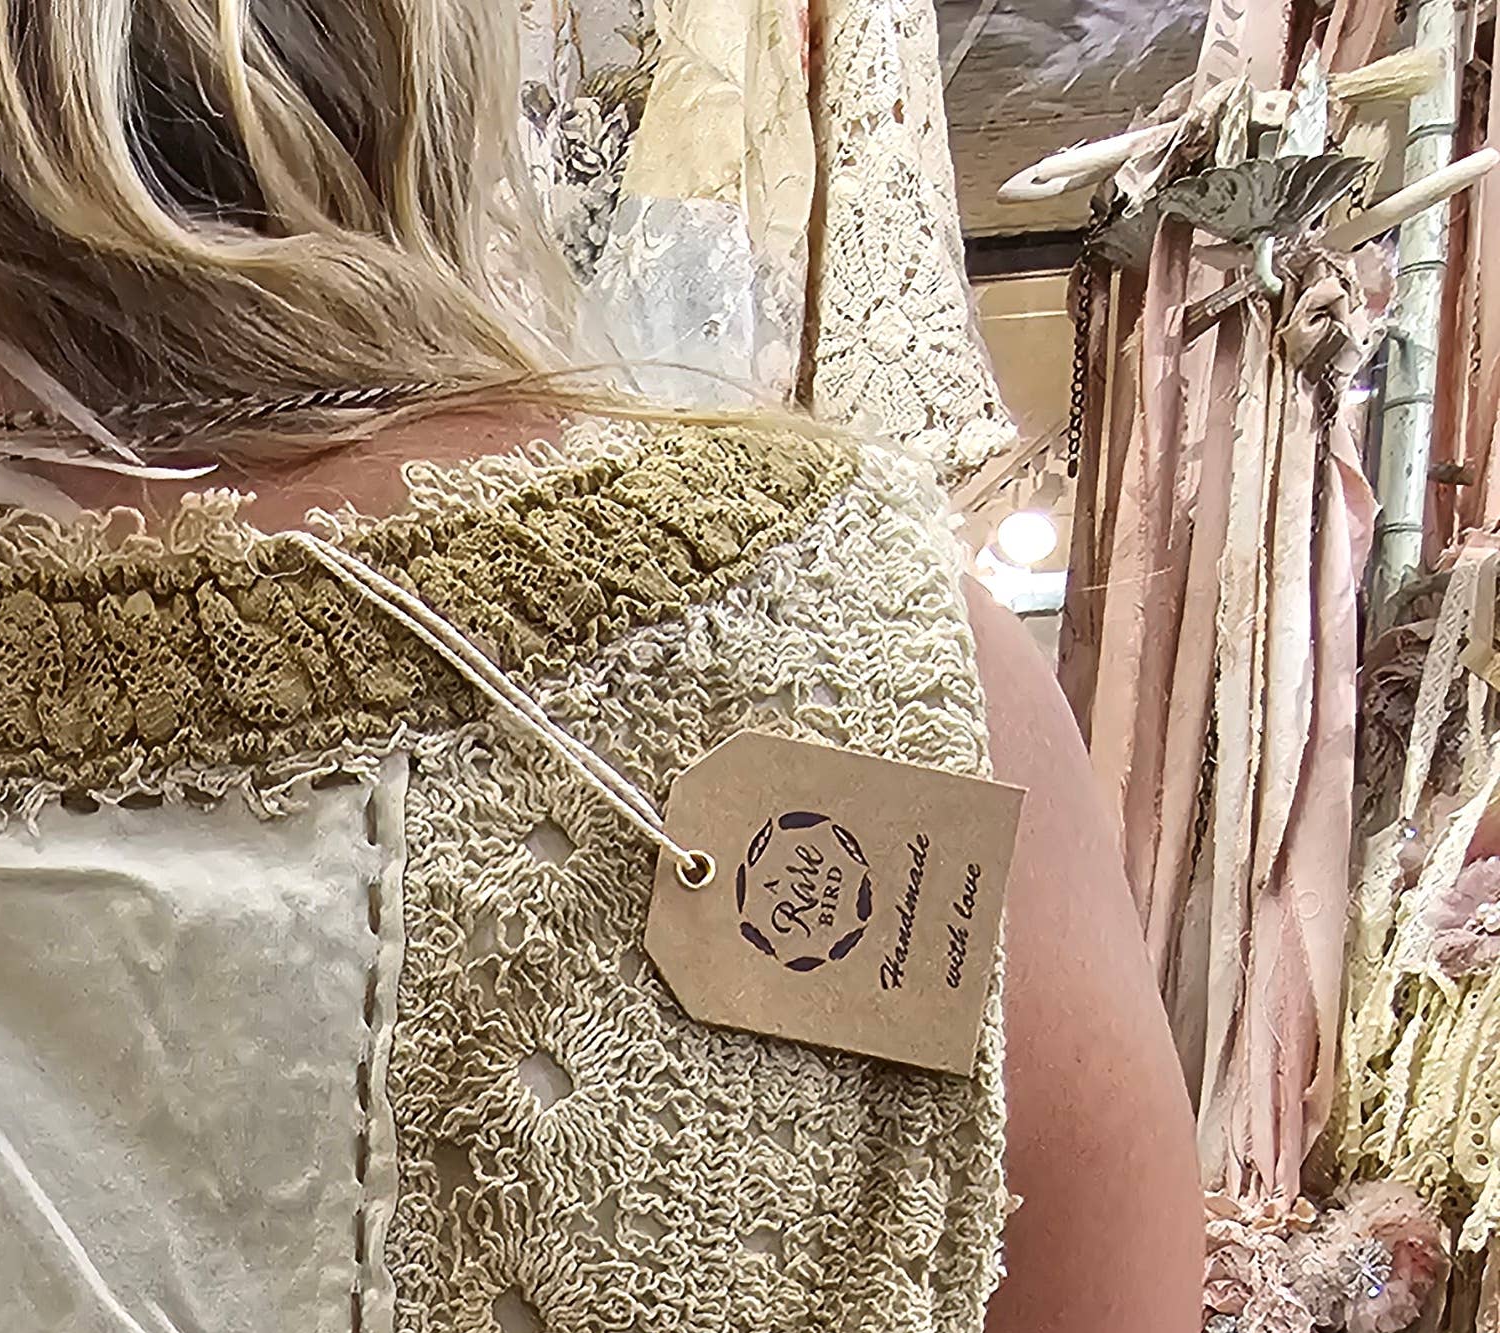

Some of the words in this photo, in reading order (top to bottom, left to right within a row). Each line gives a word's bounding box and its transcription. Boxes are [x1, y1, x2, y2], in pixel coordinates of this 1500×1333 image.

[763, 878, 781, 895] A
[770, 844, 825, 939] Rare
[818, 865, 844, 928] BIRD
[879, 833, 931, 990] Handmade
[953, 863, 982, 920] love
[946, 923, 970, 989] with
